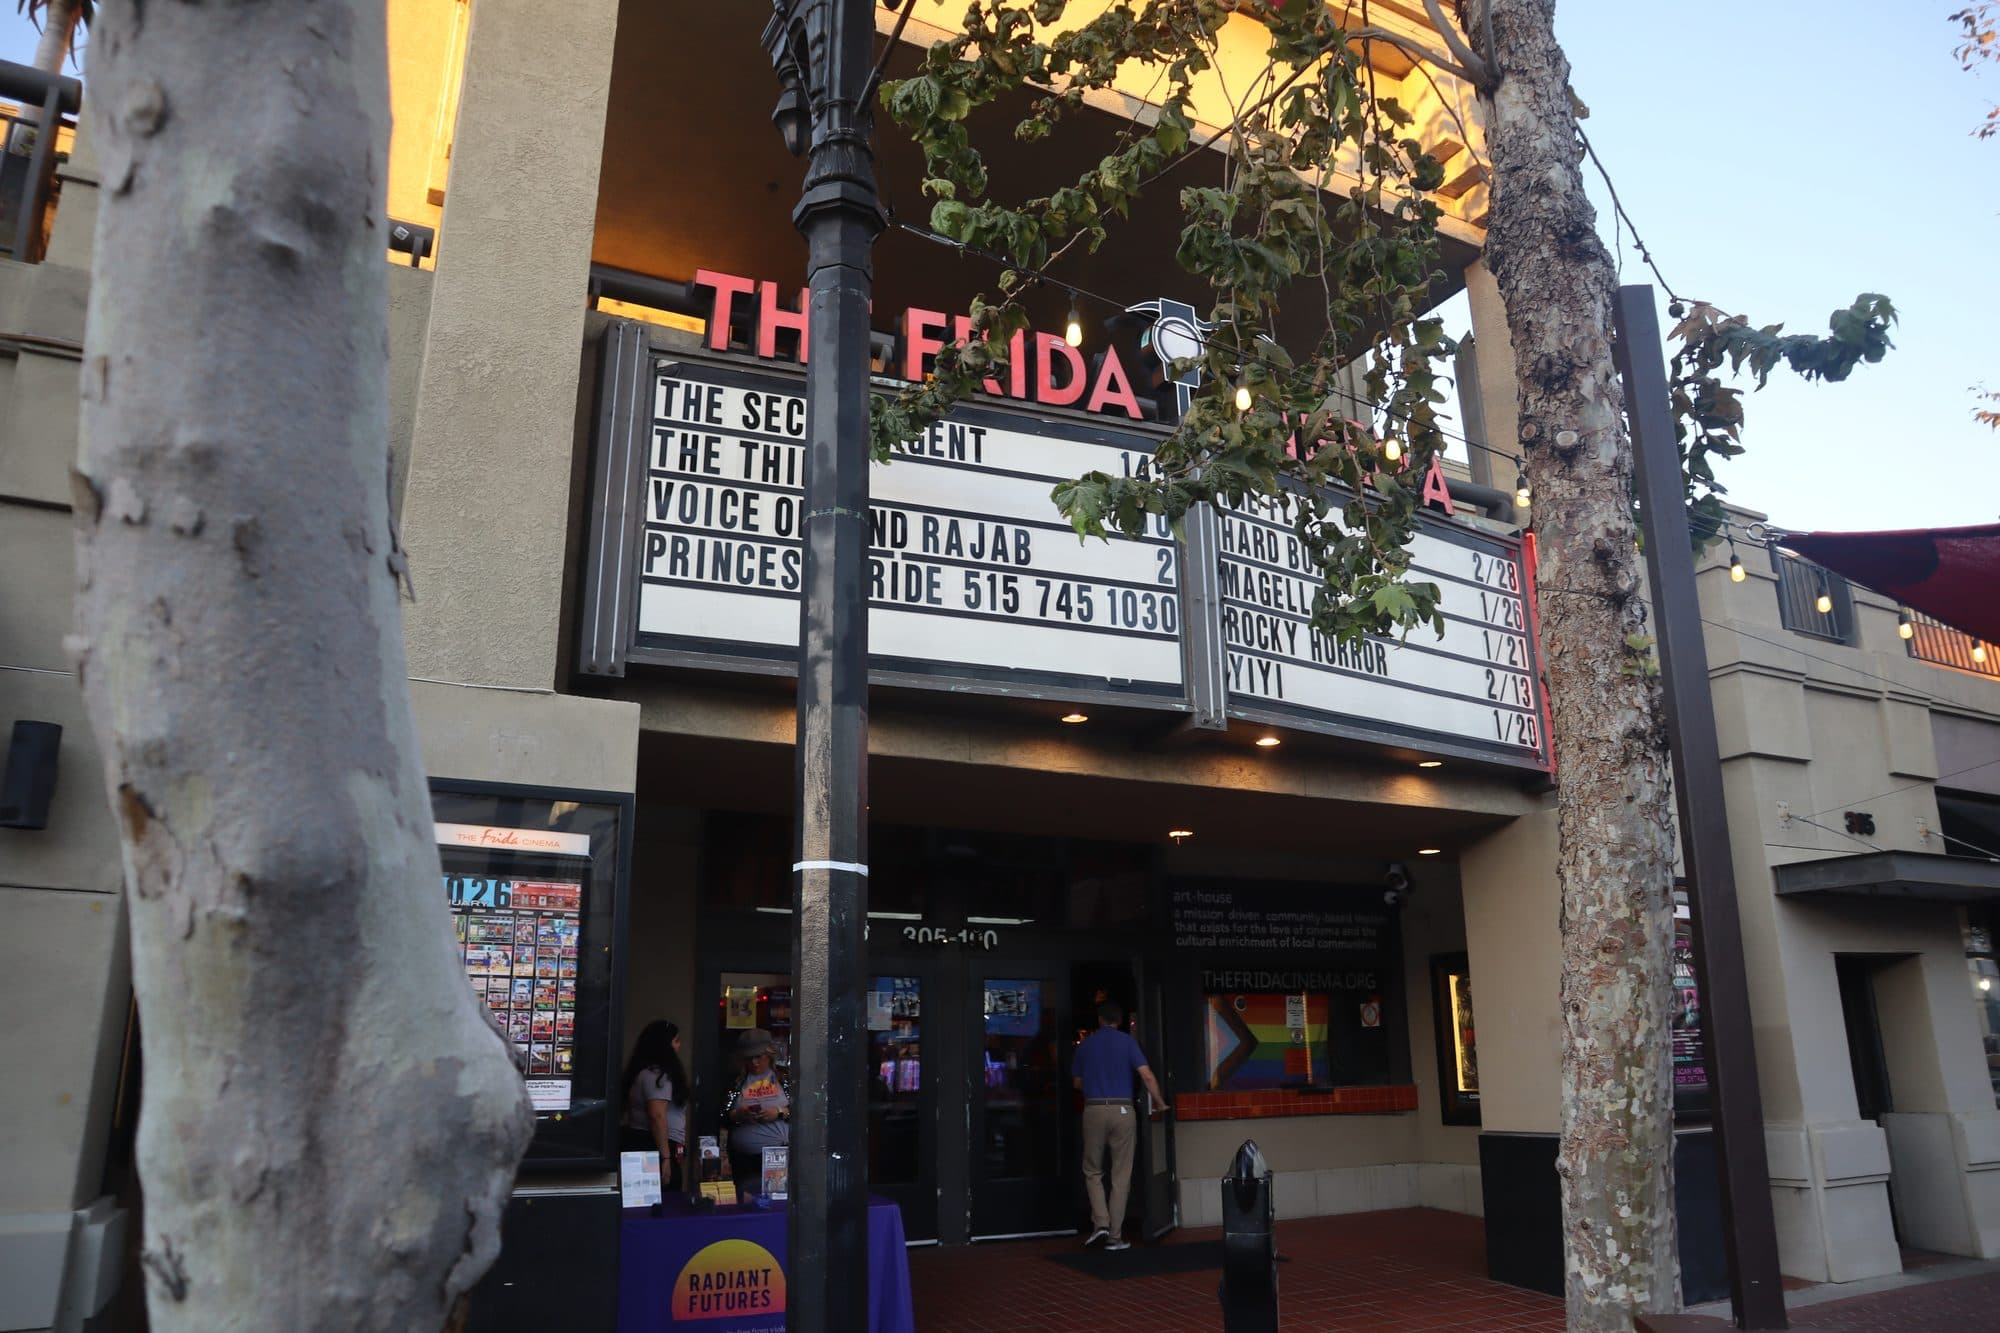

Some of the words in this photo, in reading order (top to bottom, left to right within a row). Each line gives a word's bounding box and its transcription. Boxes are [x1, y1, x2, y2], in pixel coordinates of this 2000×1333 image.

[695, 268, 872, 364] TH
[660, 379, 724, 425] THE
[742, 391, 804, 436] SEC
[900, 420, 987, 463] GENT
[654, 428, 722, 475] THE
[739, 440, 806, 487] THI
[653, 480, 760, 532] VOICE
[775, 496, 804, 537] O
[868, 508, 908, 549] ND
[922, 515, 1032, 566] RAJAB
[1156, 547, 1174, 585] 2
[645, 532, 801, 590] PRINCES
[868, 558, 943, 606] RIDE
[964, 569, 1020, 614] 515
[1035, 579, 1094, 623] 745
[1107, 588, 1177, 633] 1030
[1222, 517, 1280, 564] HARD
[1480, 591, 1523, 631] 1/26
[1472, 551, 1518, 592] 2/28
[1221, 561, 1335, 616] MAGELL
[1483, 629, 1527, 668] 1/21
[1226, 606, 1297, 655] ROCKY
[1486, 668, 1531, 708] 2/13
[1229, 653, 1283, 699] YIYI
[1493, 709, 1537, 748] 1/20
[456, 832, 477, 842] THE
[521, 838, 561, 849] CINEMA
[448, 876, 512, 909] 026
[1173, 889, 1233, 904] art-house
[1174, 921, 1198, 933] that
[1269, 924, 1291, 935] love
[1183, 908, 1224, 920] mission
[1176, 934, 1217, 947] cultural
[1218, 936, 1277, 949] enrichment
[1292, 936, 1315, 949] local
[1201, 968, 1377, 990] THEFRIDACINEMA.ORG
[689, 1268, 772, 1293] RADIANT
[688, 1289, 772, 1314] FUTURES
